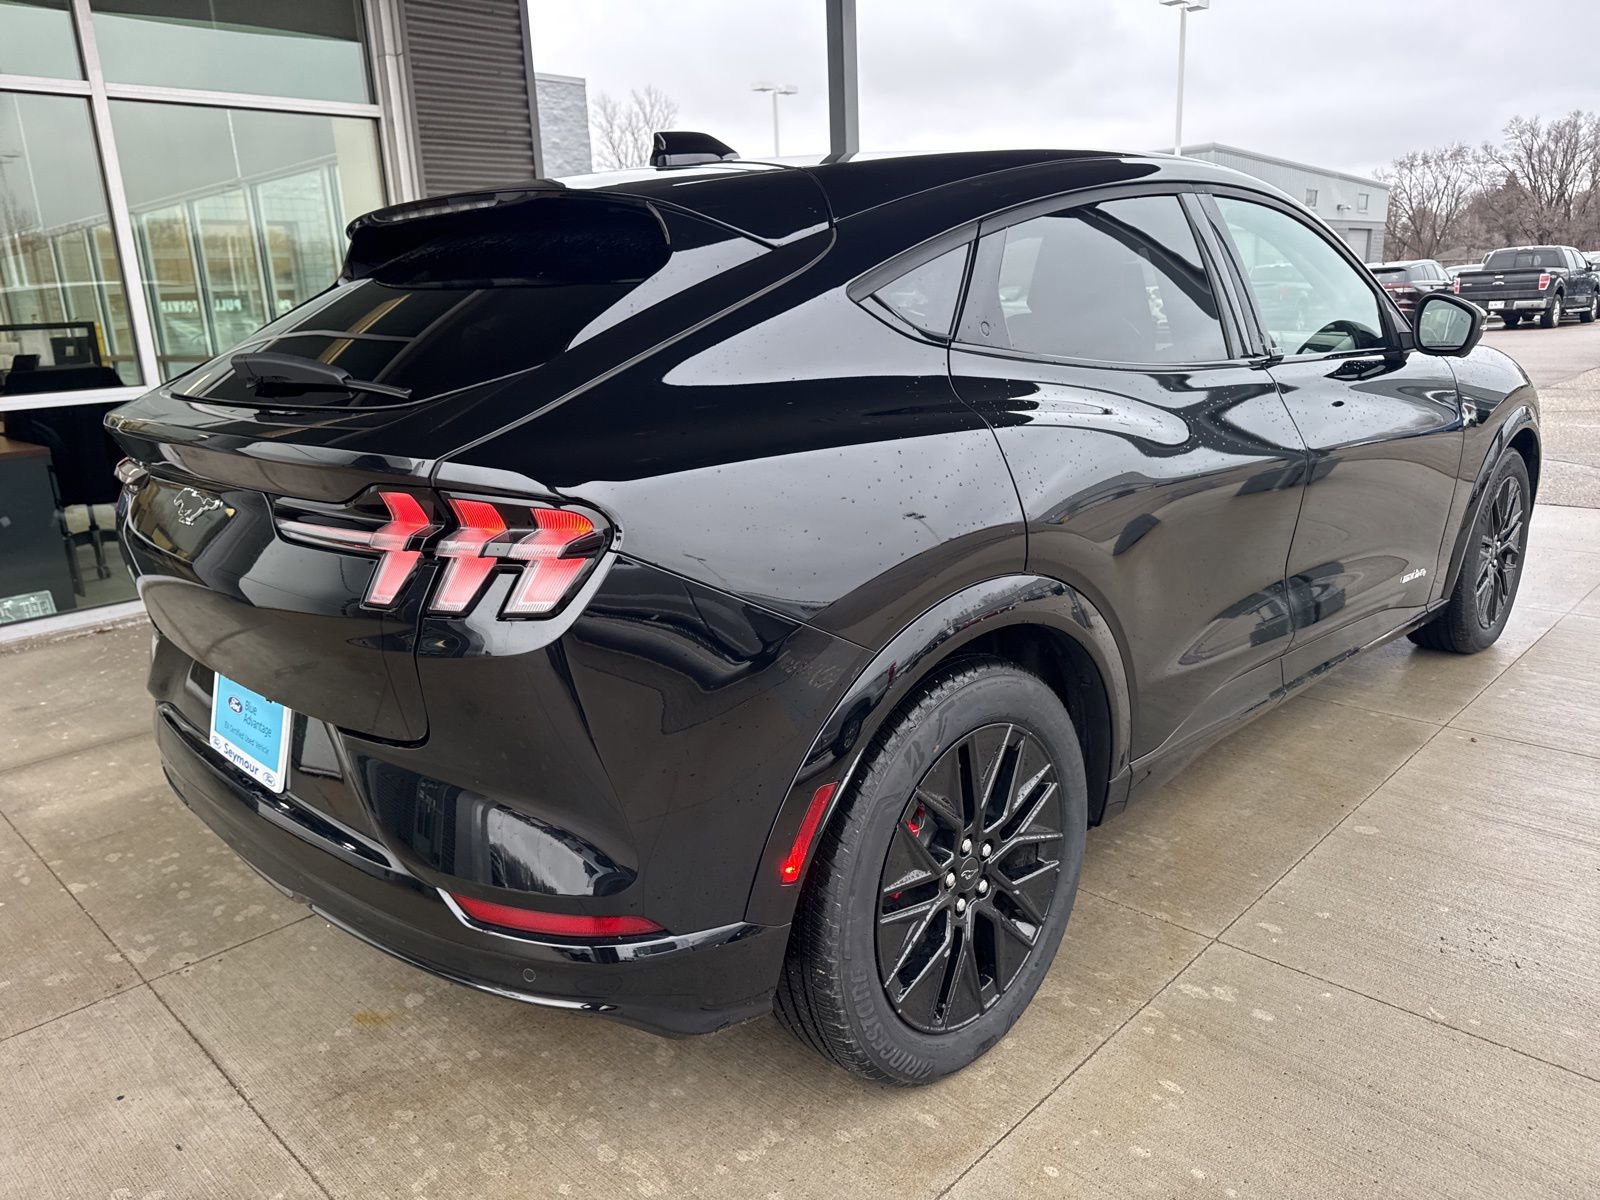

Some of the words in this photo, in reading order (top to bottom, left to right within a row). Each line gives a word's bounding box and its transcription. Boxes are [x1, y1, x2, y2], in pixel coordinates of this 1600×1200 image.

[245, 700, 257, 716] Blue
[243, 713, 272, 738] Advantage
[224, 743, 259, 775] Seymour
